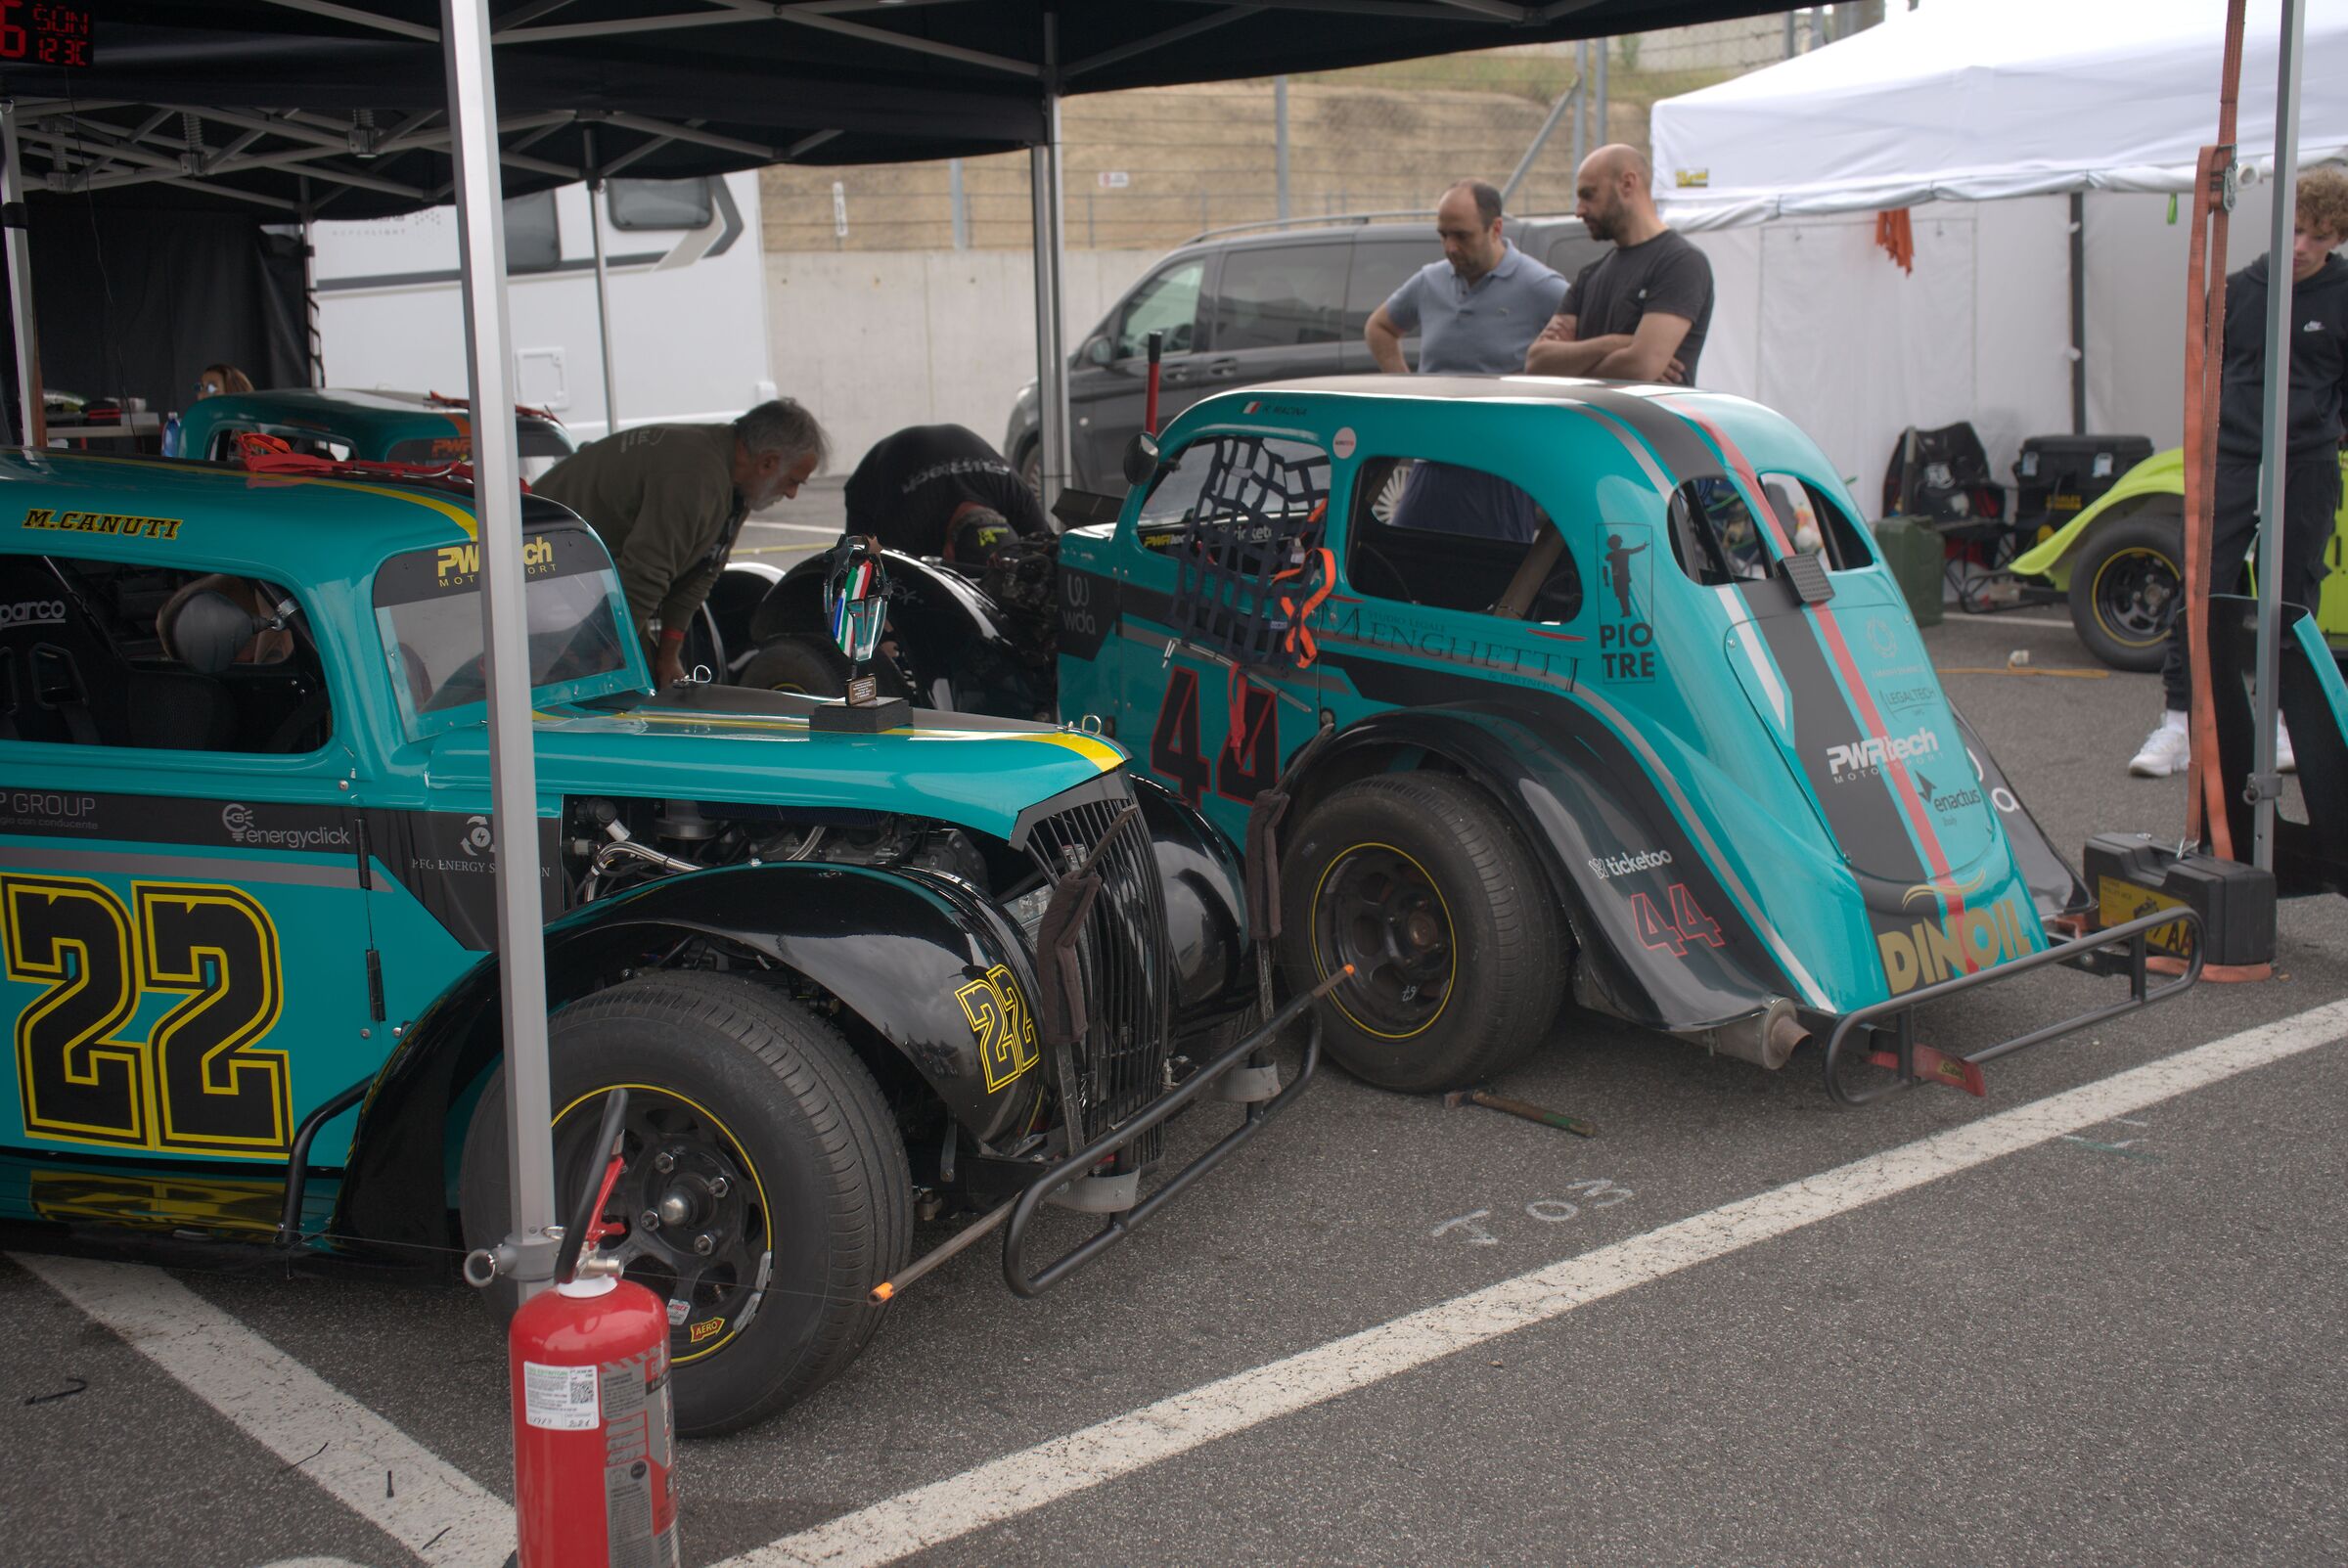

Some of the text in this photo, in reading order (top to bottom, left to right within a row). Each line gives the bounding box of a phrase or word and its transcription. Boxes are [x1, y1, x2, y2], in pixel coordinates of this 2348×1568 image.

[22, 509, 183, 540] M.CANUTI
[1600, 622, 1653, 650] PIO
[1602, 651, 1655, 679] TRE
[1150, 665, 1281, 810] 44
[1826, 726, 1939, 776] PWRtech
[13, 793, 97, 817] GROUP
[1933, 787, 1982, 813] enactus
[38, 819, 99, 830] conducente
[246, 827, 351, 849] energyclick
[437, 859, 486, 874] ENERGY
[1606, 849, 1673, 877] ticketoo
[1630, 882, 1727, 958] 44
[1876, 899, 2033, 996] DINOIL
[0, 871, 294, 1161] 22
[954, 963, 1041, 1095] 22
[696, 1321, 719, 1336] AERO
